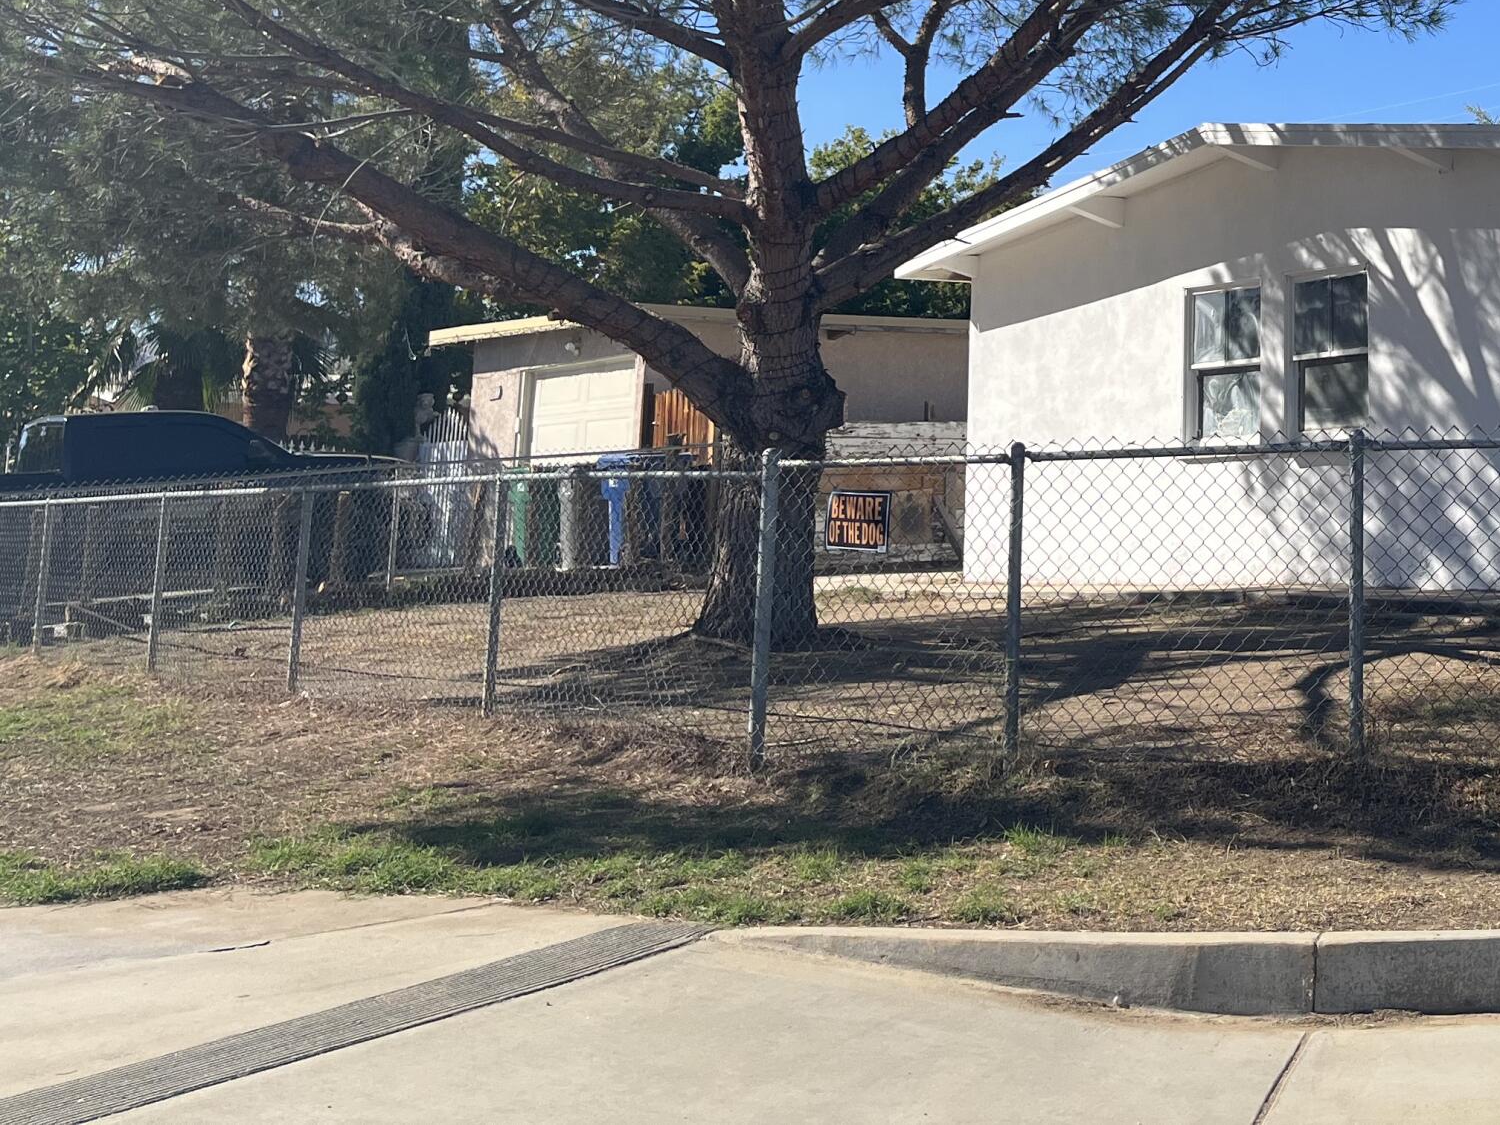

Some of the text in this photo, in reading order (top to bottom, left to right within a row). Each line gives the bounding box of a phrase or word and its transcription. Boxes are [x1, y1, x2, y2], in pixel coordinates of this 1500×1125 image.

[831, 495, 883, 521] BEWARE
[828, 520, 884, 545] OF THE DOG
